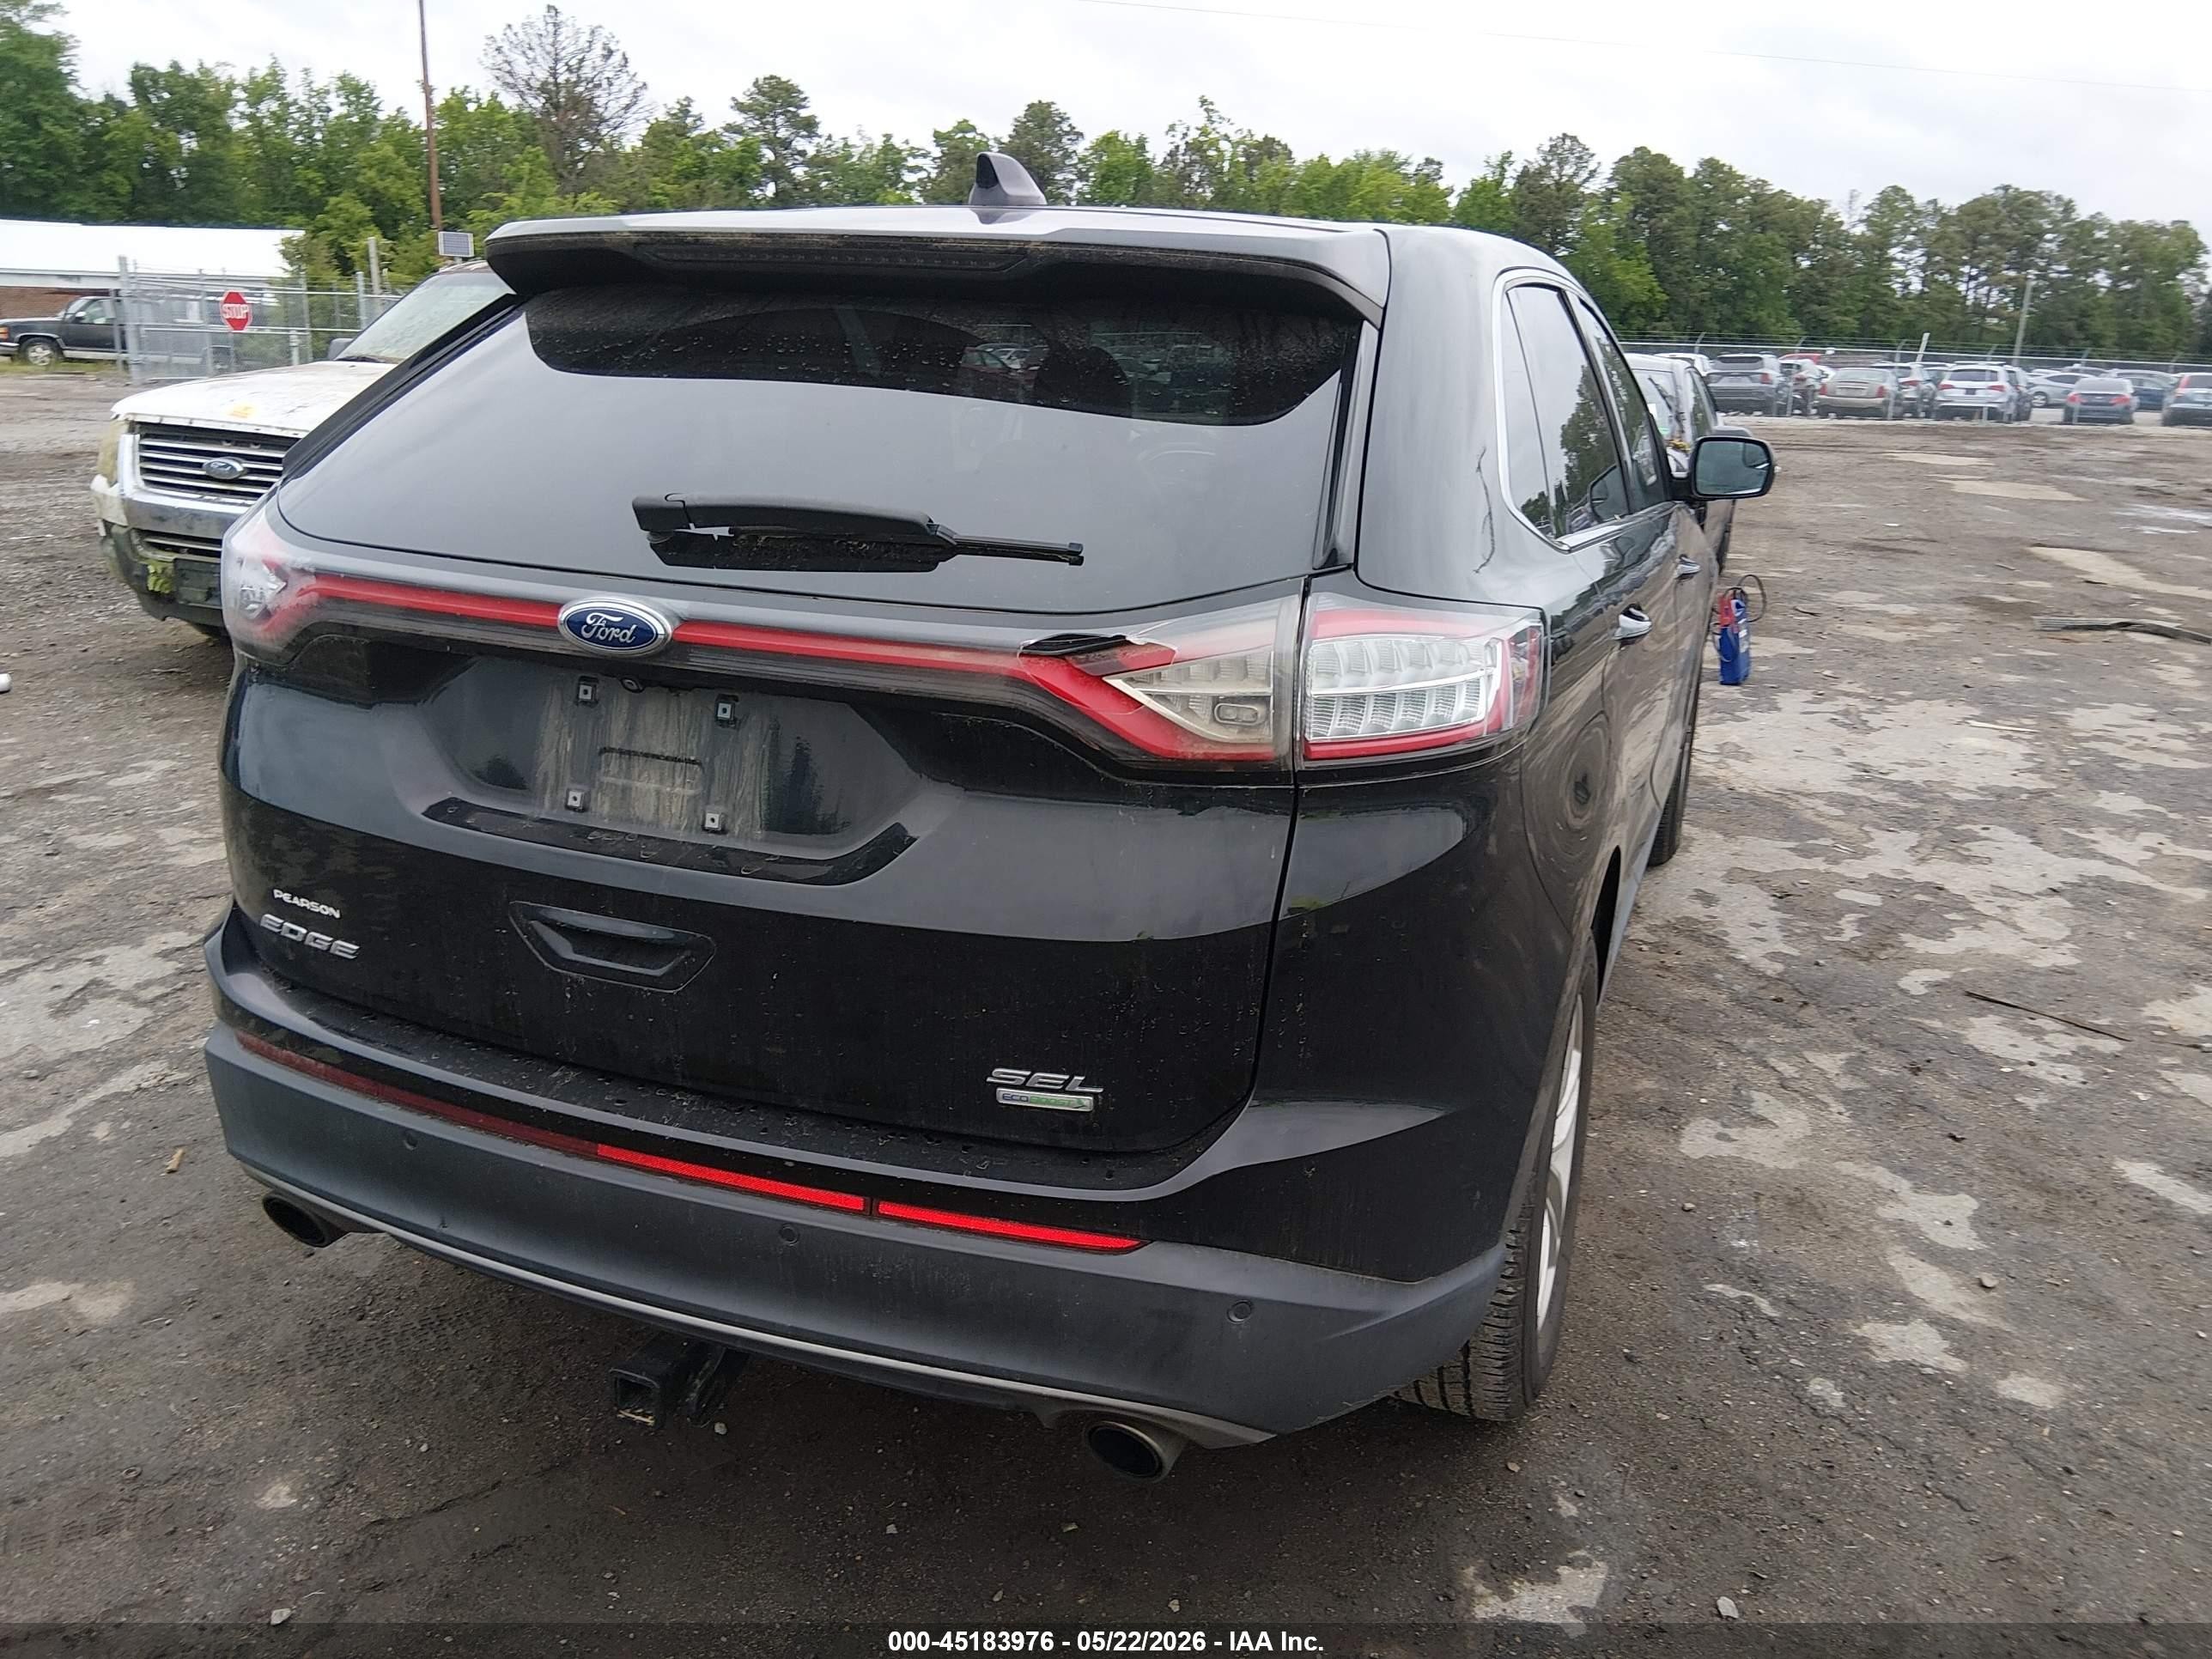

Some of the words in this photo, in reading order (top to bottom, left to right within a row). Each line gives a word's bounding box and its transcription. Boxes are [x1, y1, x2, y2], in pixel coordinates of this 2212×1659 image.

[222, 303, 249, 319] STOP
[580, 612, 639, 643] Ford
[272, 888, 342, 920] PEARSON
[260, 914, 361, 960] EDGE
[986, 1067, 1104, 1093] SEL
